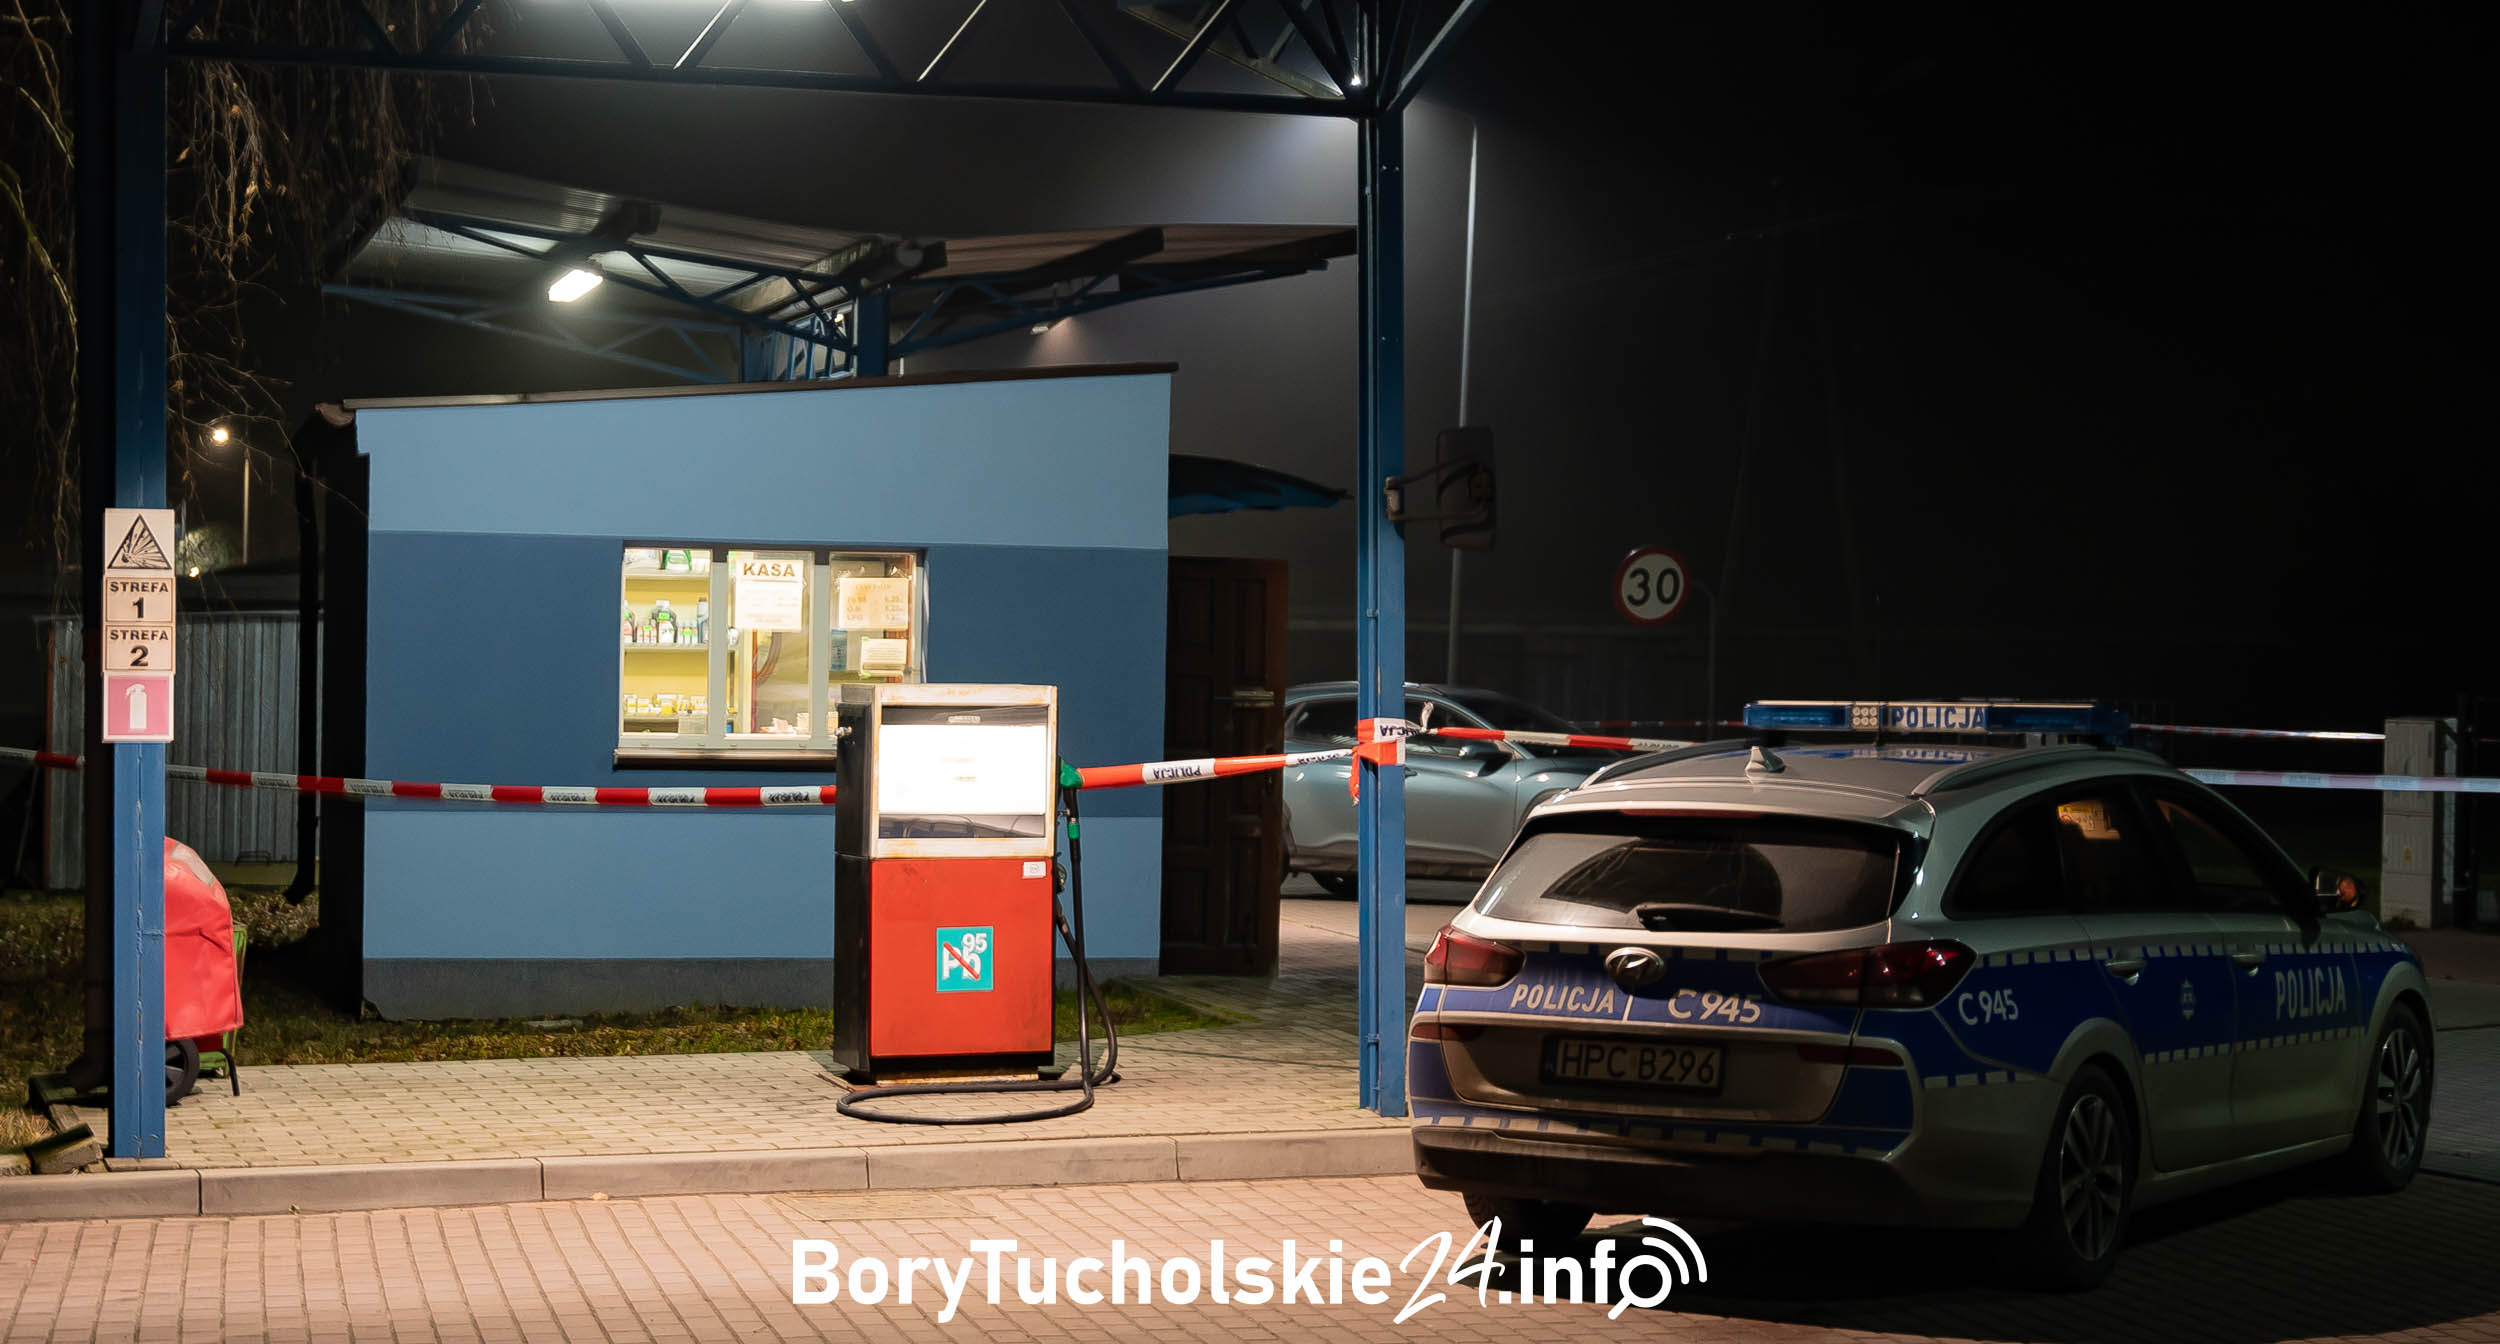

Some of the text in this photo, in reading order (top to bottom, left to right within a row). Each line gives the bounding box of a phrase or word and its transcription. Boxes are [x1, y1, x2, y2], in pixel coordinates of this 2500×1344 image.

[743, 562, 796, 578] KASA
[110, 581, 169, 593] STREFA
[1627, 567, 1680, 607] 30
[132, 597, 145, 618] 1
[110, 629, 169, 641] STREFA
[130, 646, 149, 667] 2
[1891, 705, 1985, 729] POLICJA
[1153, 765, 1201, 780] POLICJA
[961, 932, 988, 953] 95
[1510, 983, 1615, 1015] POLICJA
[2275, 966, 2347, 1019] POLICJA
[1560, 1041, 1716, 1084] HPC B296
